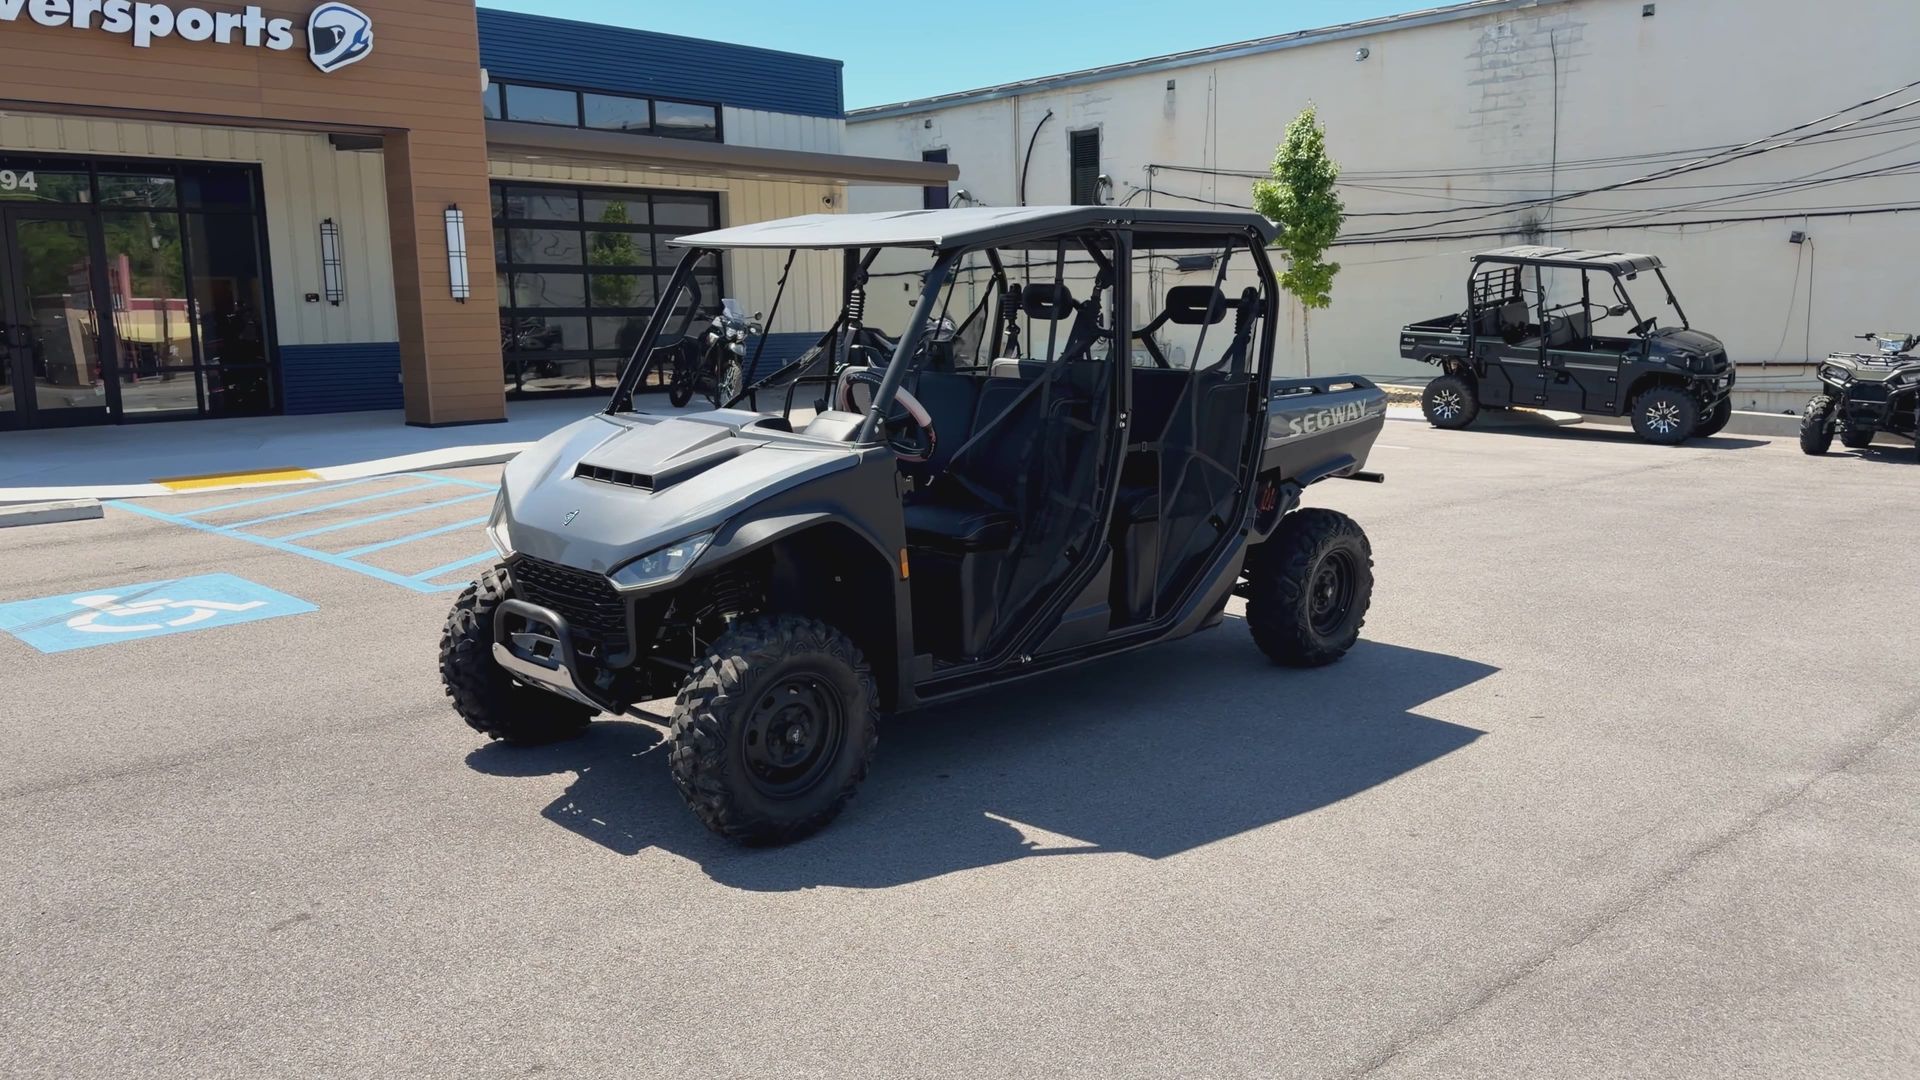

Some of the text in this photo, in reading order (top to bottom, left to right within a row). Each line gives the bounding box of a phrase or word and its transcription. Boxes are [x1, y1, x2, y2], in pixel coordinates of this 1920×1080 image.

[0, 0, 293, 51] ersports
[0, 169, 38, 191] 94
[1288, 398, 1367, 436] SEGWAY
